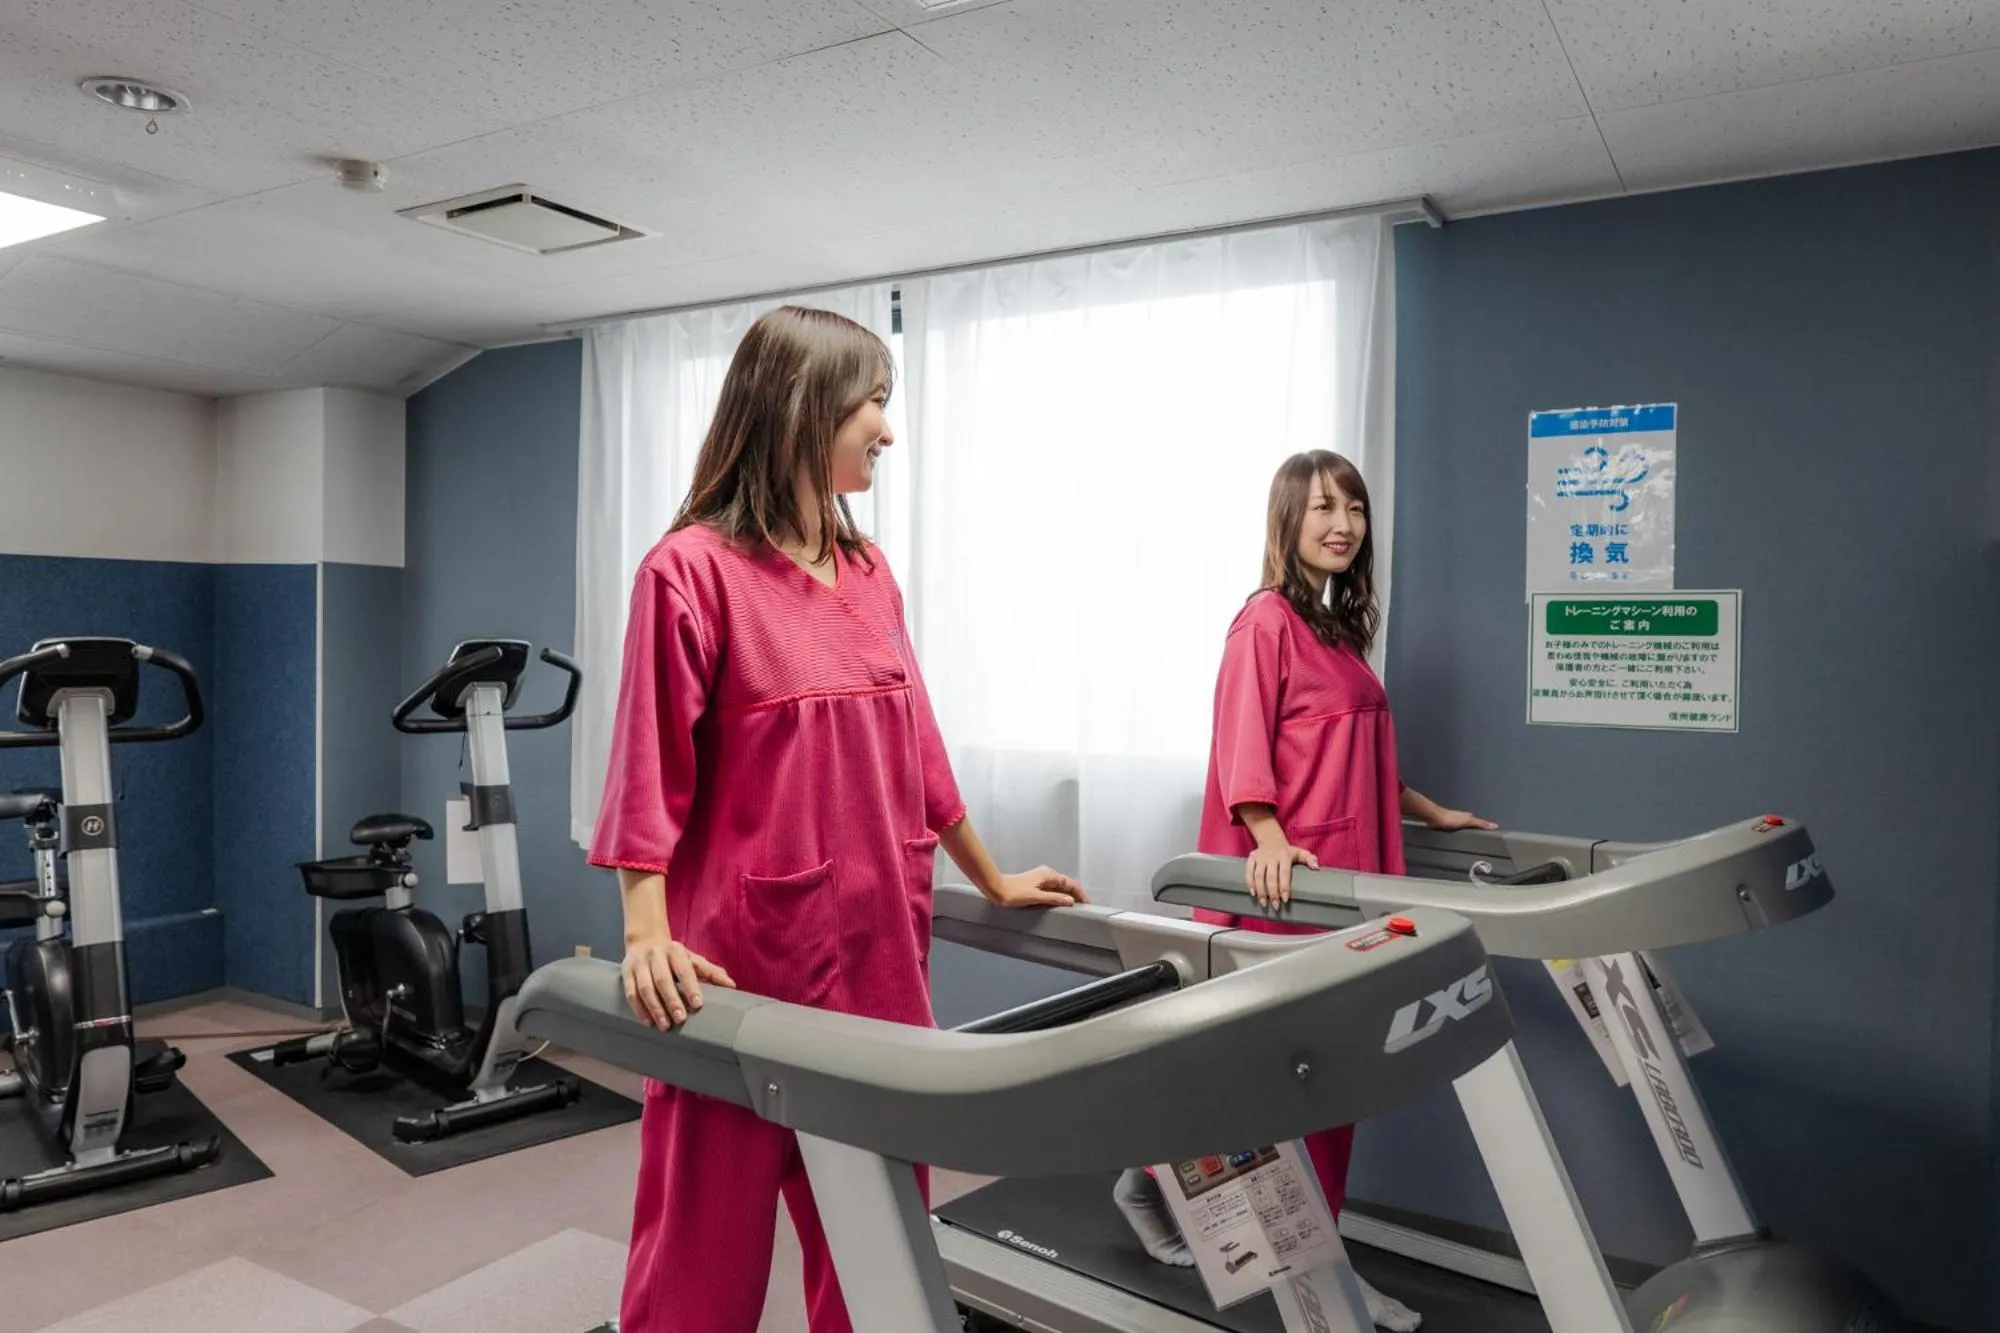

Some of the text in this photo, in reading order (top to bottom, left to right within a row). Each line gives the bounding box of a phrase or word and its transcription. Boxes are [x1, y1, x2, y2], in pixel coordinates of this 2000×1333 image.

[1570, 523, 1629, 537] 定期的に
[1570, 542, 1629, 564] 換気
[1565, 604, 1698, 617] トレーニングマシーン利用の
[1610, 619, 1650, 631] ご案内
[1383, 963, 1493, 1054] LXS
[1008, 1235, 1059, 1259] Senoh
